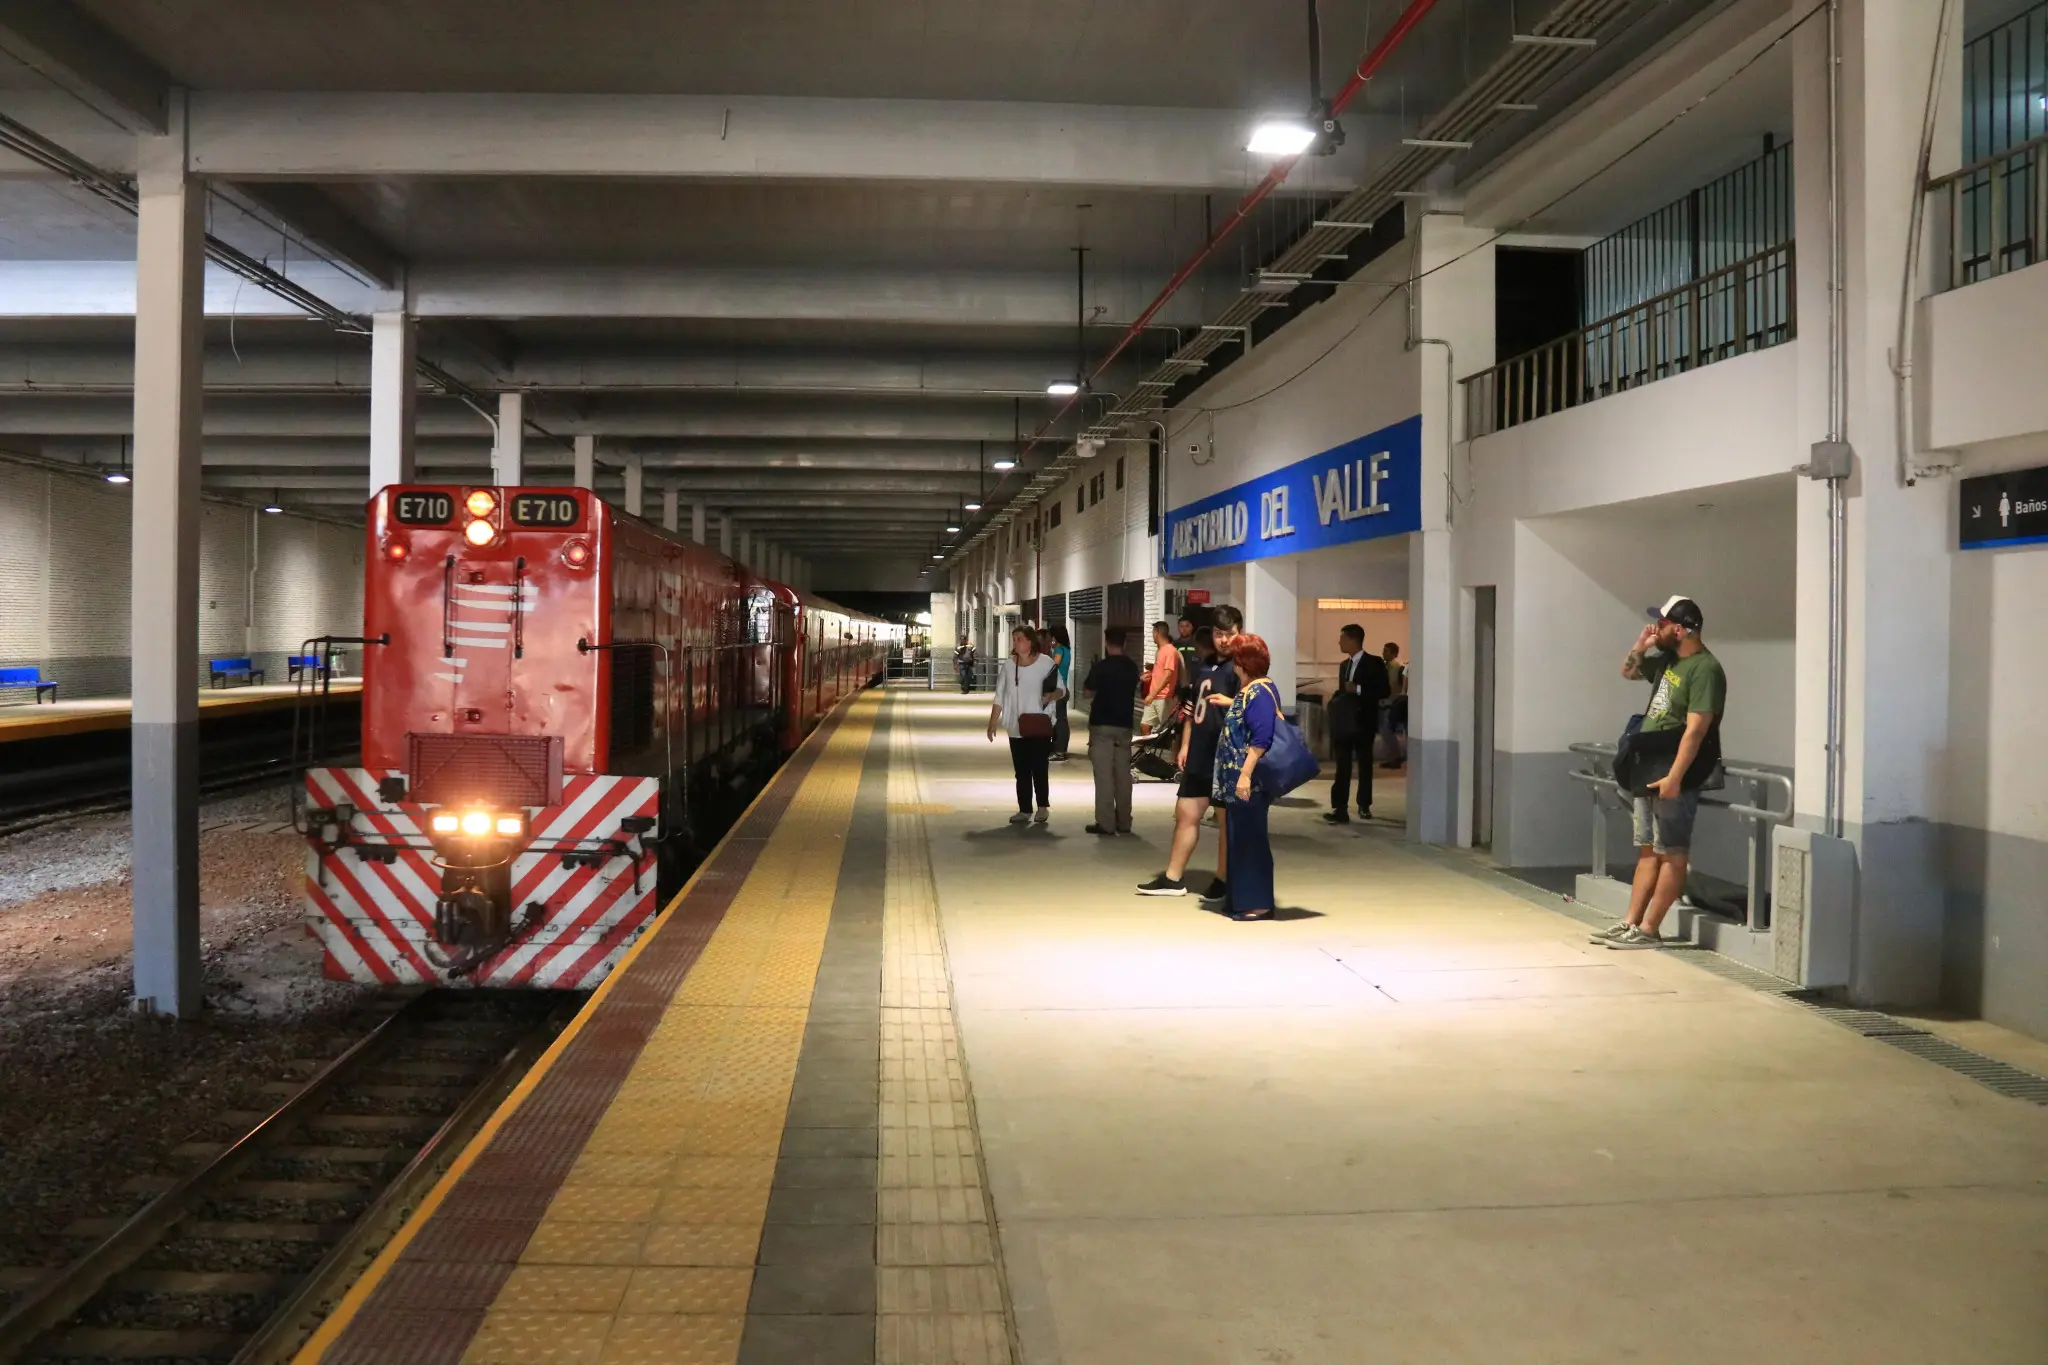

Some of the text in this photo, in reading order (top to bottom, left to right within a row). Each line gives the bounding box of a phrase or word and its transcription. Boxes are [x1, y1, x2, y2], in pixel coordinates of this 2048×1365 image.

[400, 498, 449, 519] E710
[517, 500, 573, 521] E710
[1171, 451, 1390, 559] ARISTOBULO DEL VALLE
[2015, 499, 2047, 514] Baños
[1194, 679, 1212, 724] 6
